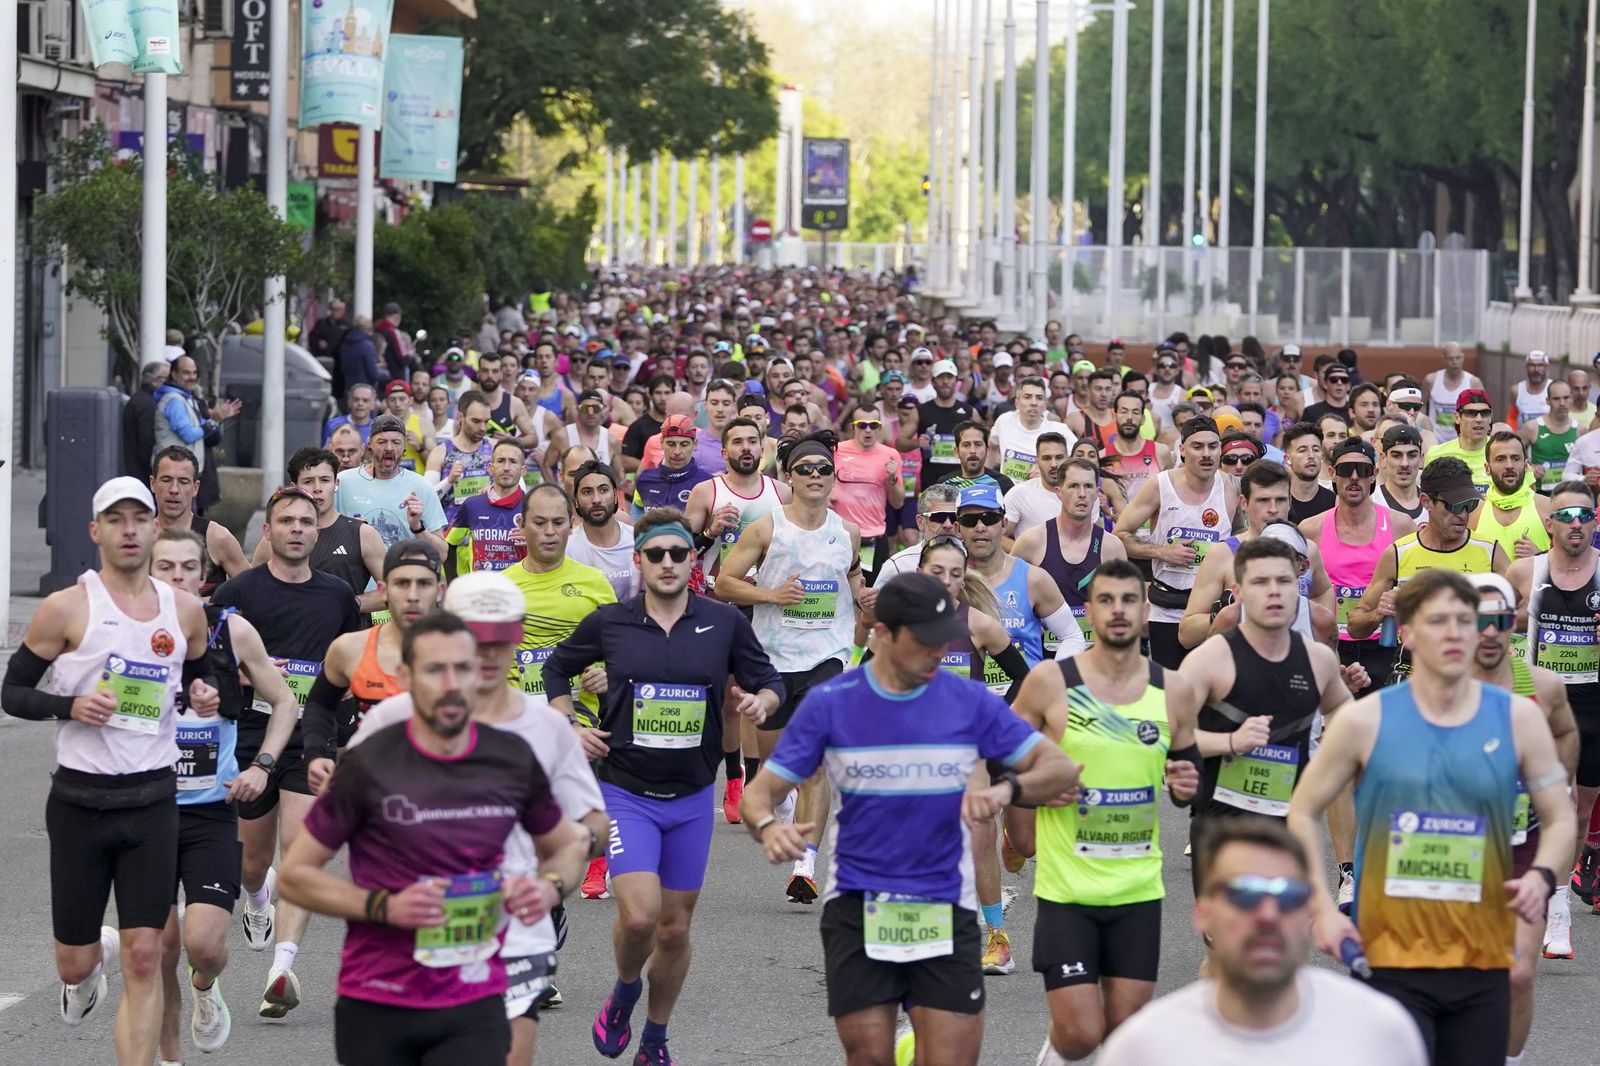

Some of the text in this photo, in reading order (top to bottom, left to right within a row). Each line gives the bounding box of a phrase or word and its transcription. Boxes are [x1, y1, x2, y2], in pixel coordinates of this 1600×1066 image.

[1185, 530, 1214, 540] ZURICH
[804, 583, 834, 592] ZURICH
[803, 597, 821, 606] 2957
[783, 608, 836, 619] SEUNGYEOP HAN
[1540, 613, 1559, 622] CLUB
[1559, 634, 1595, 644] ZURICH
[1559, 649, 1579, 659] 2204
[128, 665, 161, 679] ZURICH
[1538, 660, 1599, 673] BARTOLOME
[659, 687, 700, 699] ZURICH
[120, 701, 161, 718] GAYOSO
[659, 706, 681, 717] 2968
[636, 717, 701, 734] NICHOLAS
[1250, 746, 1292, 761] ZURICH
[845, 761, 961, 780] desam.es
[1248, 765, 1271, 778] 1845
[1242, 778, 1270, 796] LEE
[1105, 790, 1149, 803] ZURICH
[1421, 816, 1477, 833] ZURICH
[1396, 858, 1473, 880] MICHAEL
[877, 925, 940, 943] DUCLOS
